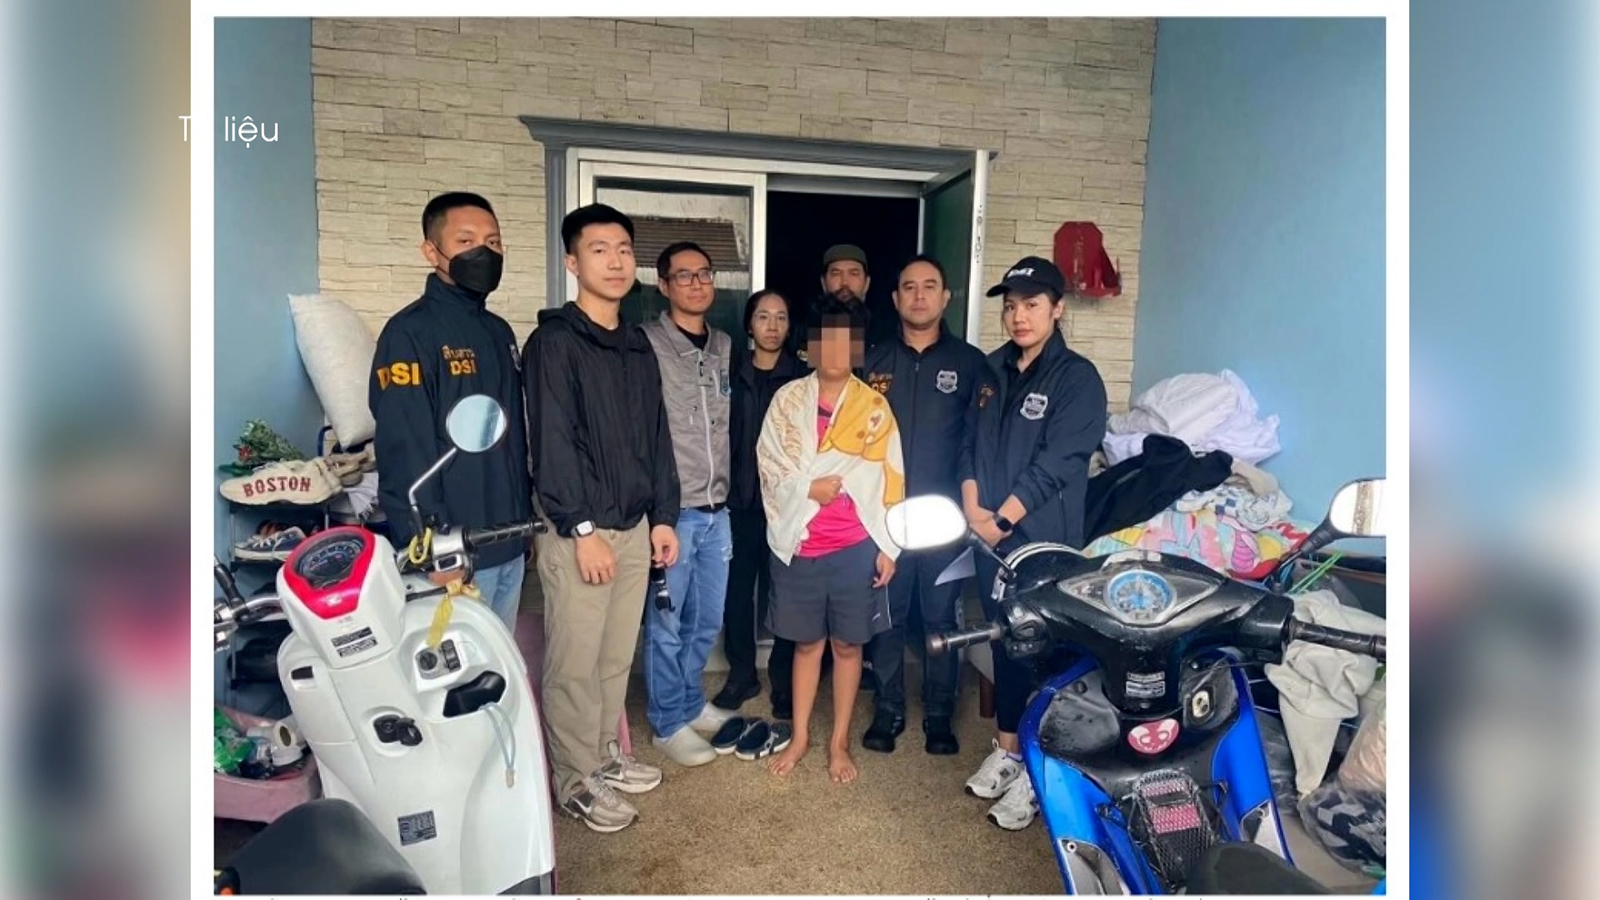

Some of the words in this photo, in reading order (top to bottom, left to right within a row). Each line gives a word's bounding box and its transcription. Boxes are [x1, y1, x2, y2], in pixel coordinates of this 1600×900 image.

[377, 362, 420, 391] DSI
[451, 360, 476, 375] DSI
[243, 477, 311, 497] BOSTON
